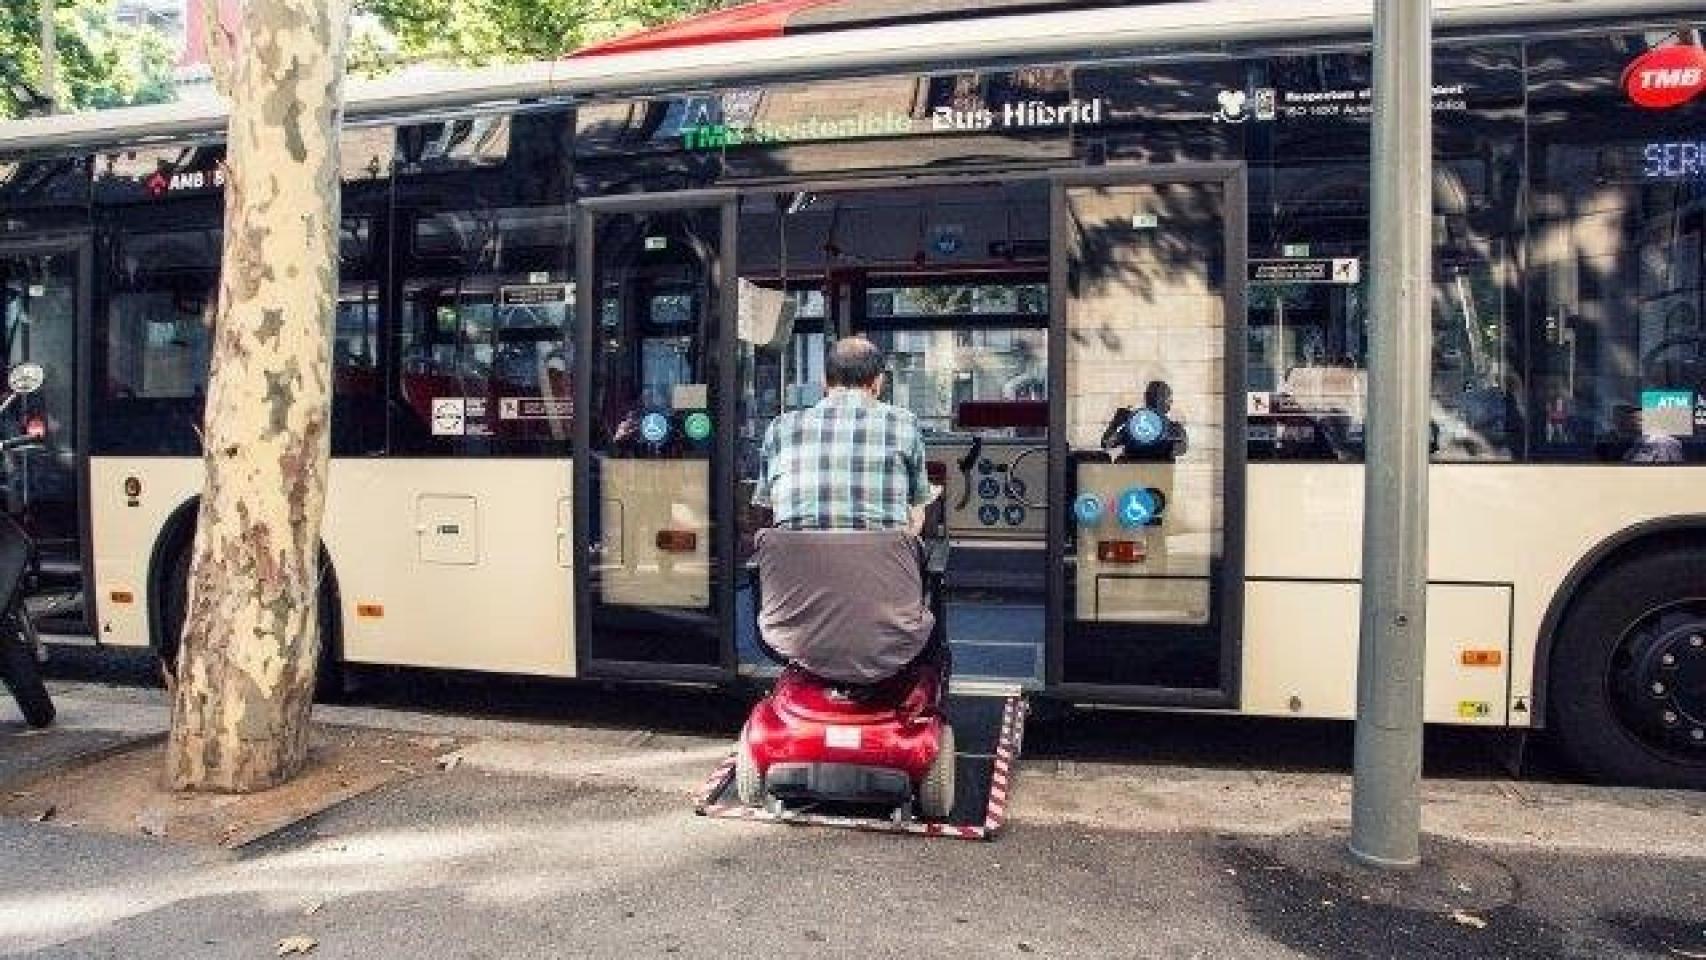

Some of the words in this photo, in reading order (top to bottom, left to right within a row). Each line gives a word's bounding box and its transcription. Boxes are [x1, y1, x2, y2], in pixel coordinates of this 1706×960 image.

[1640, 68, 1701, 89] TMB
[932, 106, 993, 131] Bus
[168, 171, 204, 190] AMB
